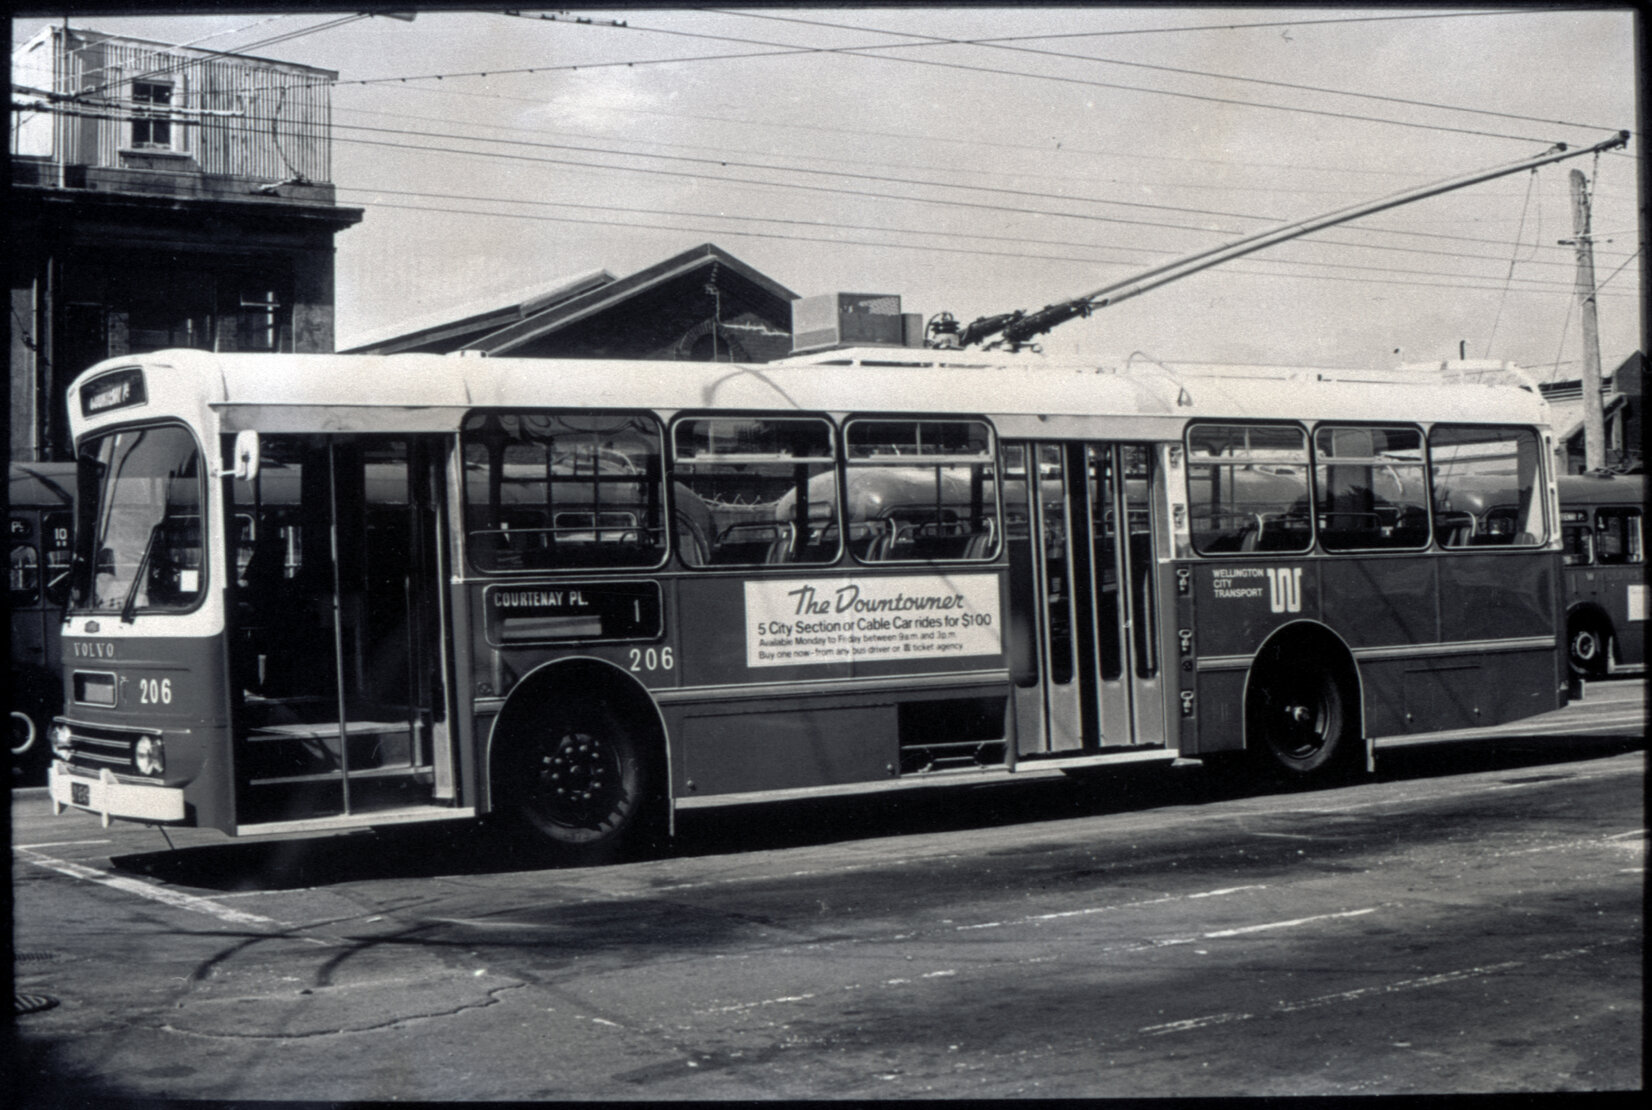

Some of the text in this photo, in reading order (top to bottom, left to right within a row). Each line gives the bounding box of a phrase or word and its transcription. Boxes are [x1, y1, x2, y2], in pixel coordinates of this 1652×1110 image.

[1212, 568, 1265, 578] WELLINGTON
[1213, 579, 1232, 588] CITY
[494, 591, 564, 607] COURTENAY
[788, 584, 965, 615] The Downtowner
[1213, 588, 1264, 598] TRANSPORT
[758, 622, 766, 635] 5
[769, 621, 792, 636] City
[795, 619, 841, 634] Section
[843, 621, 855, 631] or
[857, 617, 891, 631] Cable
[893, 616, 912, 630] Car
[915, 615, 942, 629] rides
[944, 615, 959, 627] for
[760, 638, 793, 647] Available
[795, 636, 826, 646] Monday
[828, 636, 836, 644] to
[863, 632, 897, 643] between
[920, 631, 934, 640] and
[74, 642, 114, 658] VOLVO
[759, 650, 775, 660] Buy
[777, 650, 792, 658] one
[836, 647, 850, 657] any
[852, 646, 866, 655] bus
[868, 645, 890, 654] driver
[892, 645, 901, 653] or
[912, 642, 934, 651] ticket
[937, 642, 963, 653] agency
[630, 647, 674, 671] 206
[140, 678, 171, 704] 206
